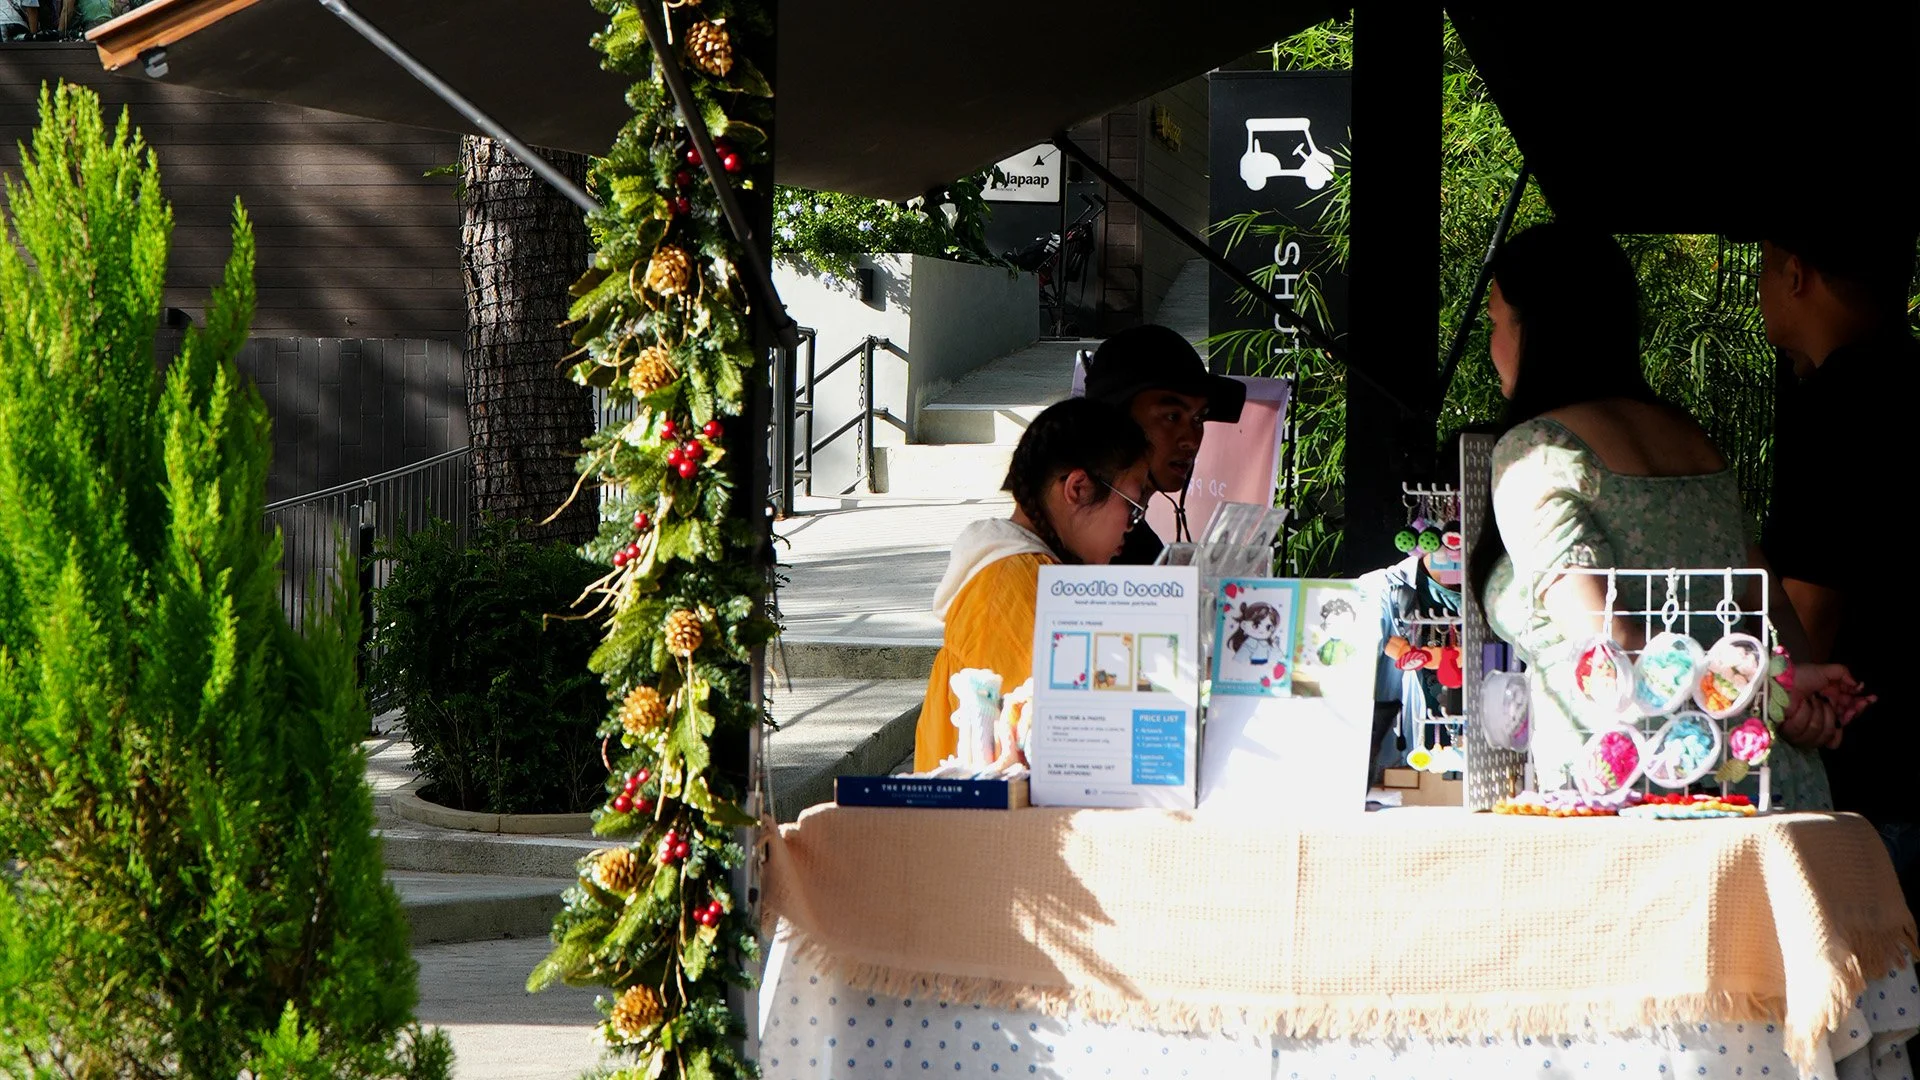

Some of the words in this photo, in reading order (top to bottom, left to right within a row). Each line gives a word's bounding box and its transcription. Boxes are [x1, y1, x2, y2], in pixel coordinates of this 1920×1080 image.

[996, 171, 1049, 188] lapaap
[1051, 580, 1118, 597] doodle
[1123, 580, 1184, 598] booth
[1139, 714, 1161, 723] PRICE
[1163, 715, 1179, 723] LIST
[881, 783, 898, 791] THE
[901, 784, 933, 792] FROSTY
[936, 785, 963, 793] CABIN
